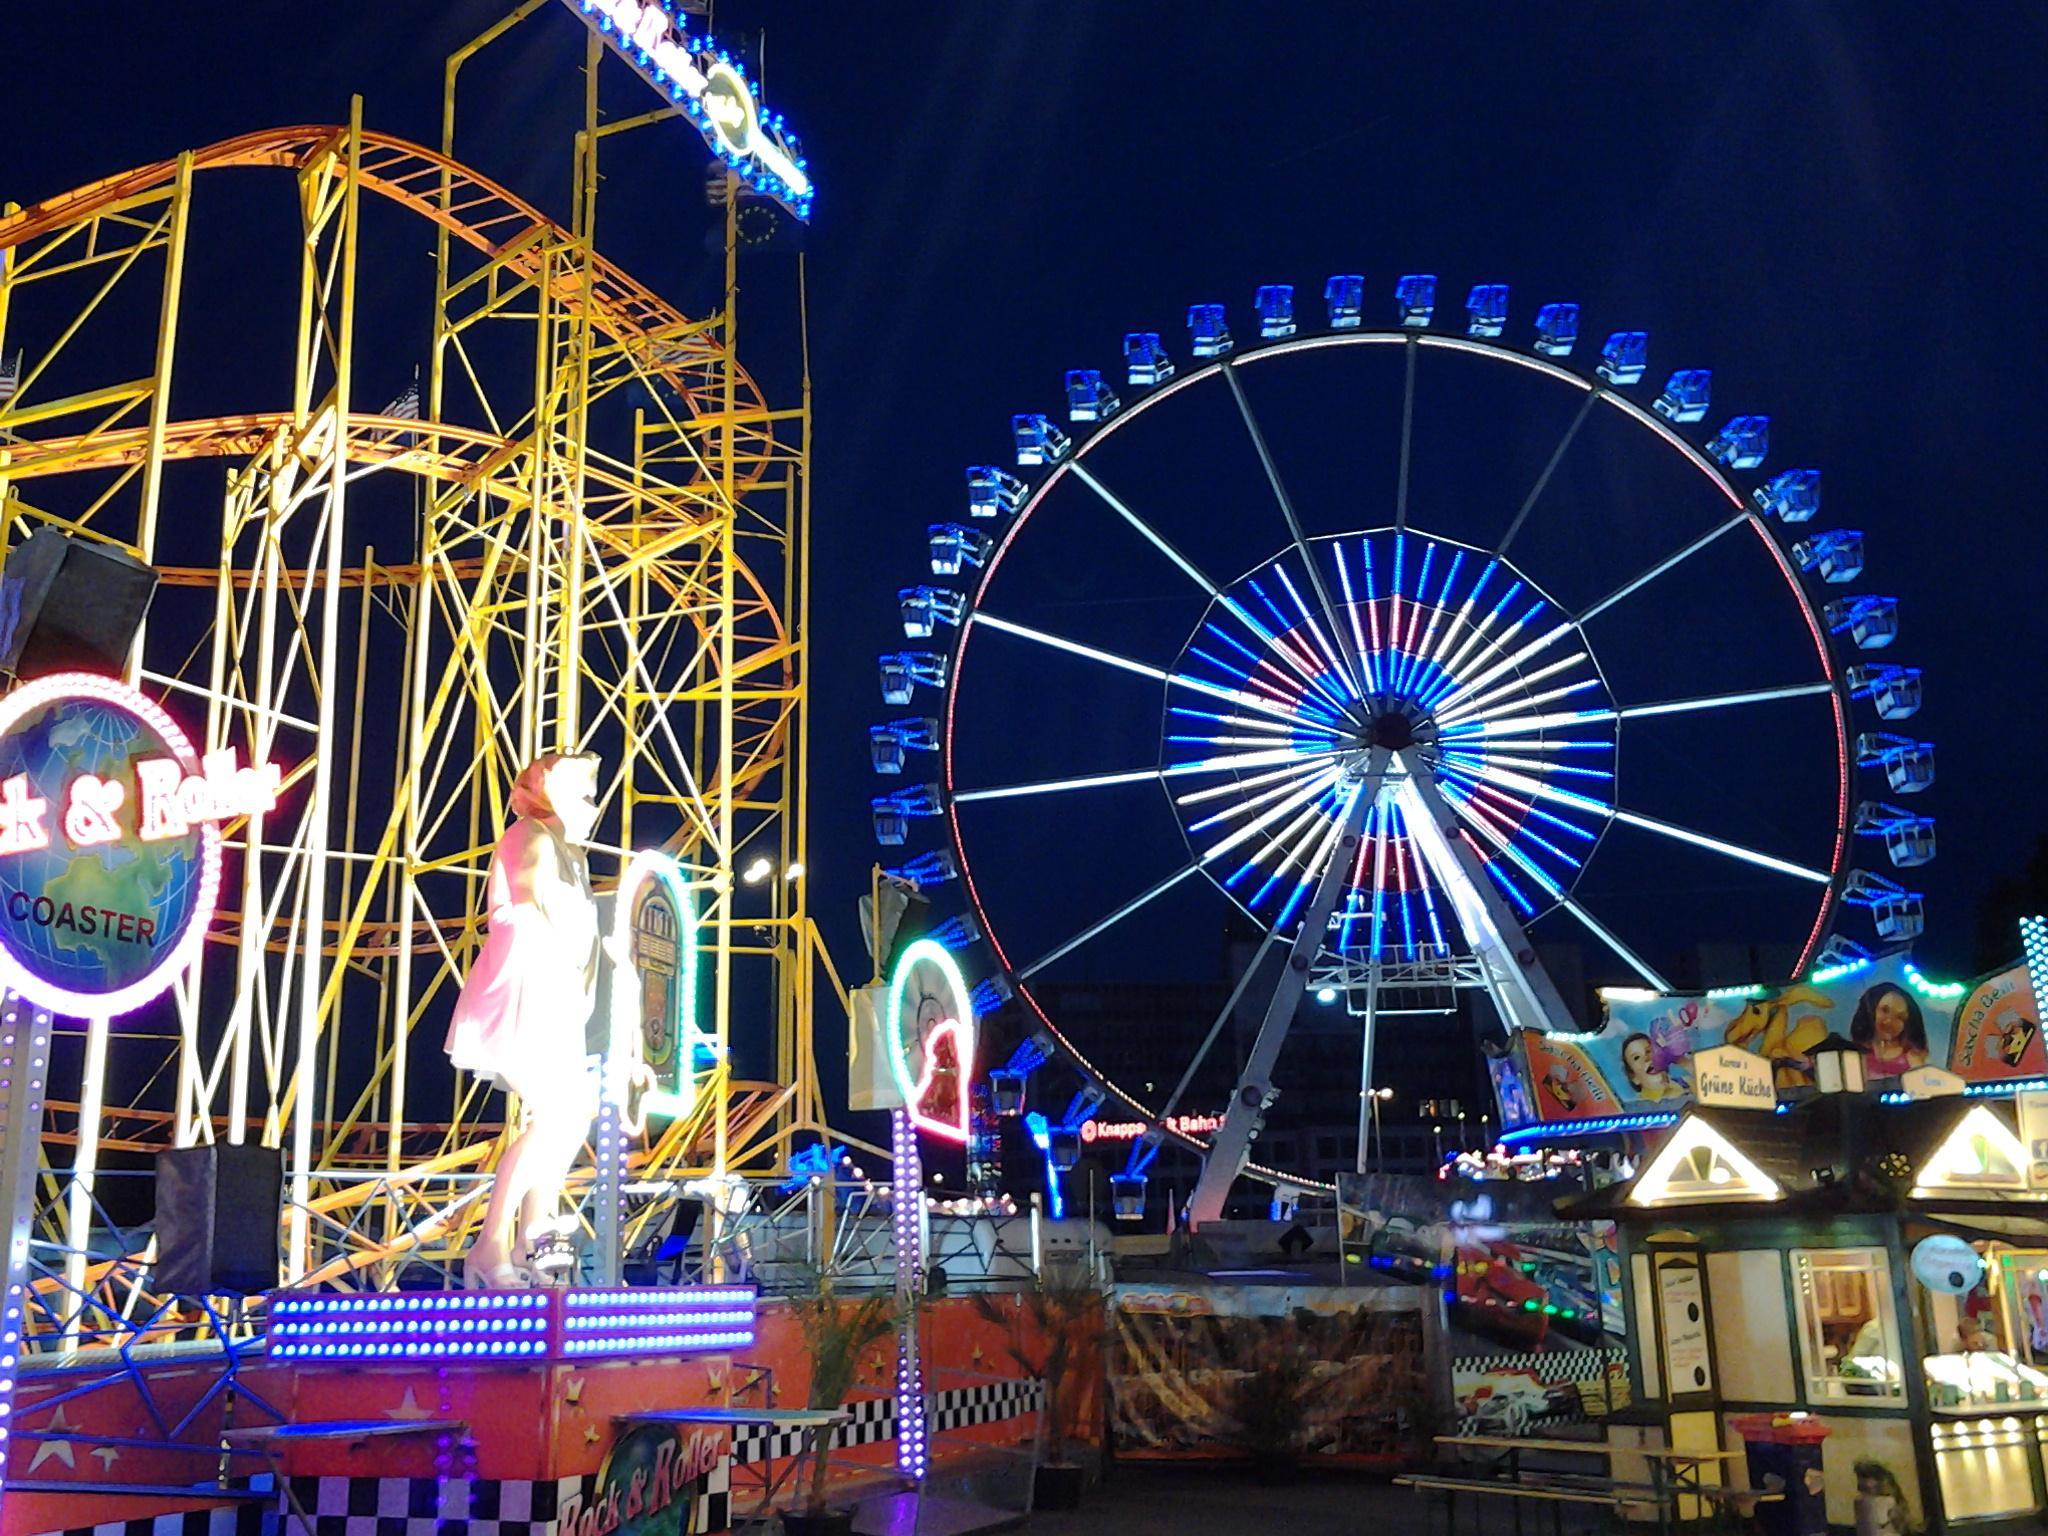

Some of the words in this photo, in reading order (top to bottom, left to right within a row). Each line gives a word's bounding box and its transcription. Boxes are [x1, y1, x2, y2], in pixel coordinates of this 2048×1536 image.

[65, 773, 125, 847] &
[8, 891, 156, 947] COASTER
[1700, 1072, 1734, 1098] Grüne
[1739, 1075, 1772, 1098] Küche
[1180, 1115, 1217, 1131] Bahn
[555, 1479, 621, 1536] Rock
[648, 1429, 723, 1516] Roller
